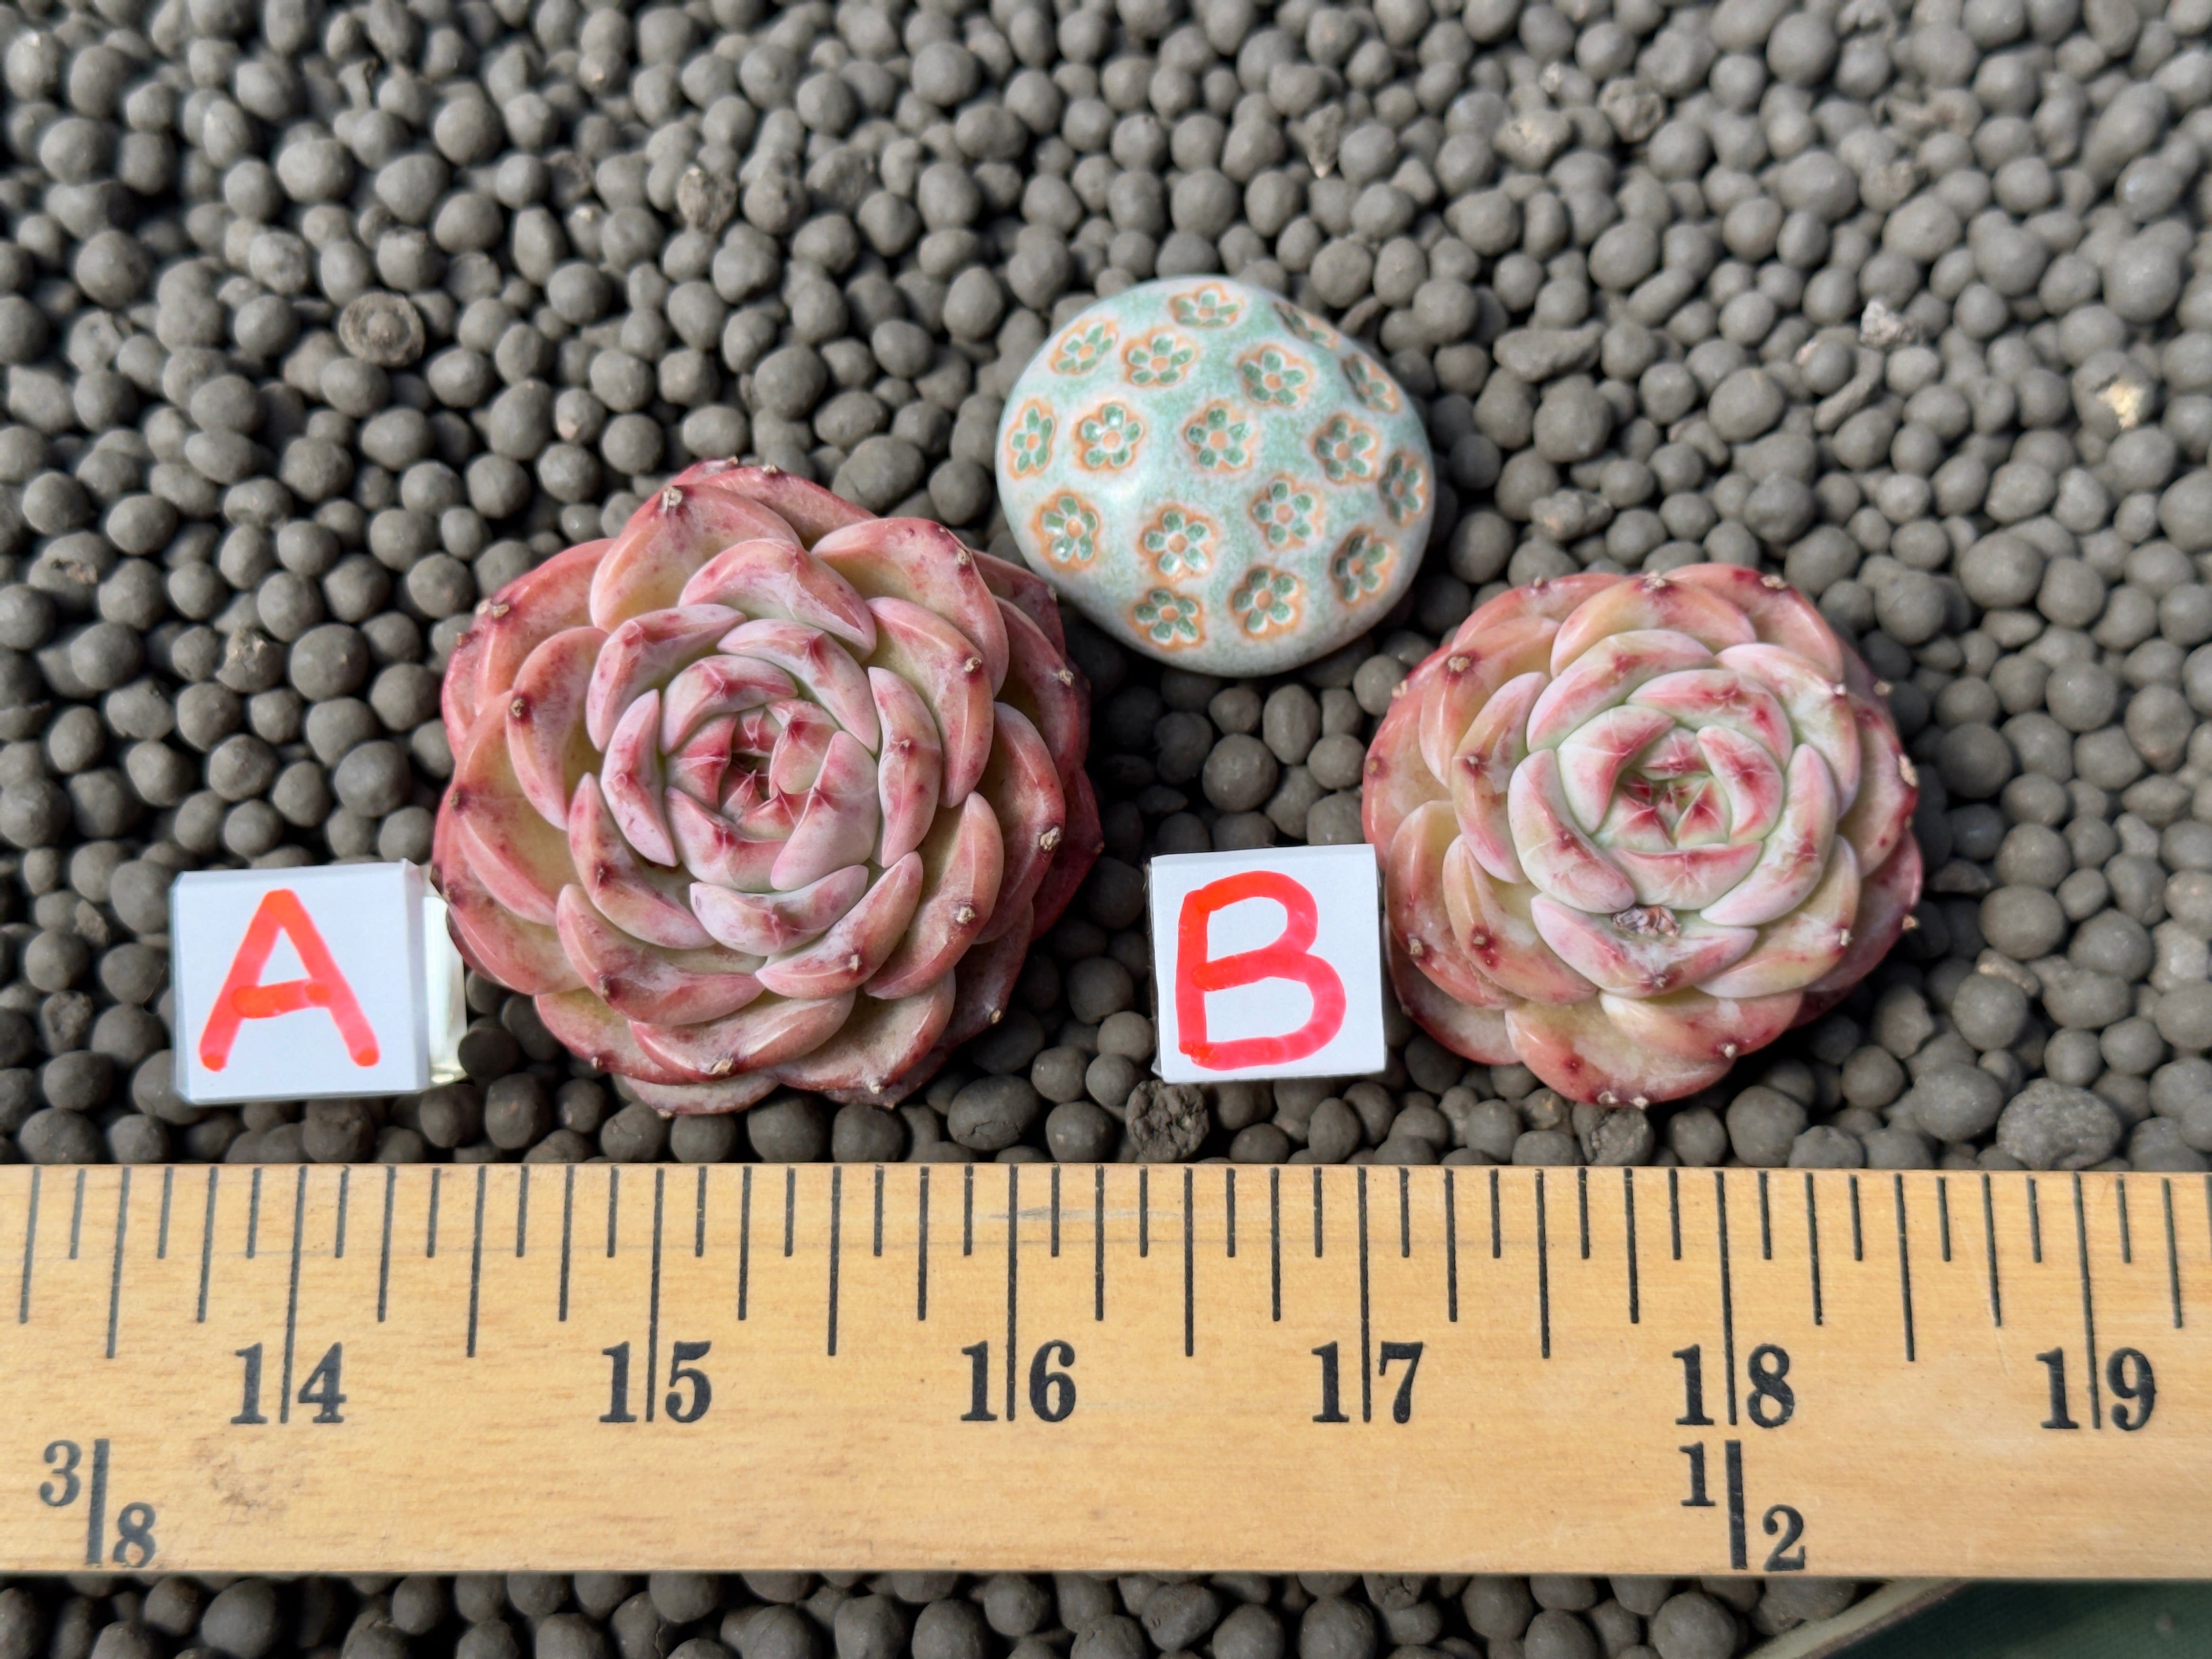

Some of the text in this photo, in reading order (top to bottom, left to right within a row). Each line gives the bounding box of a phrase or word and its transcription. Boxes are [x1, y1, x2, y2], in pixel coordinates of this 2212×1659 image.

[198, 888, 380, 1072] A
[1174, 870, 1347, 1071] B
[230, 1342, 347, 1425] 14
[599, 1341, 712, 1423] 15
[960, 1340, 1077, 1423] 16
[1311, 1340, 1424, 1424] 17
[1672, 1343, 1796, 1429] 18
[2035, 1347, 2158, 1432] 19
